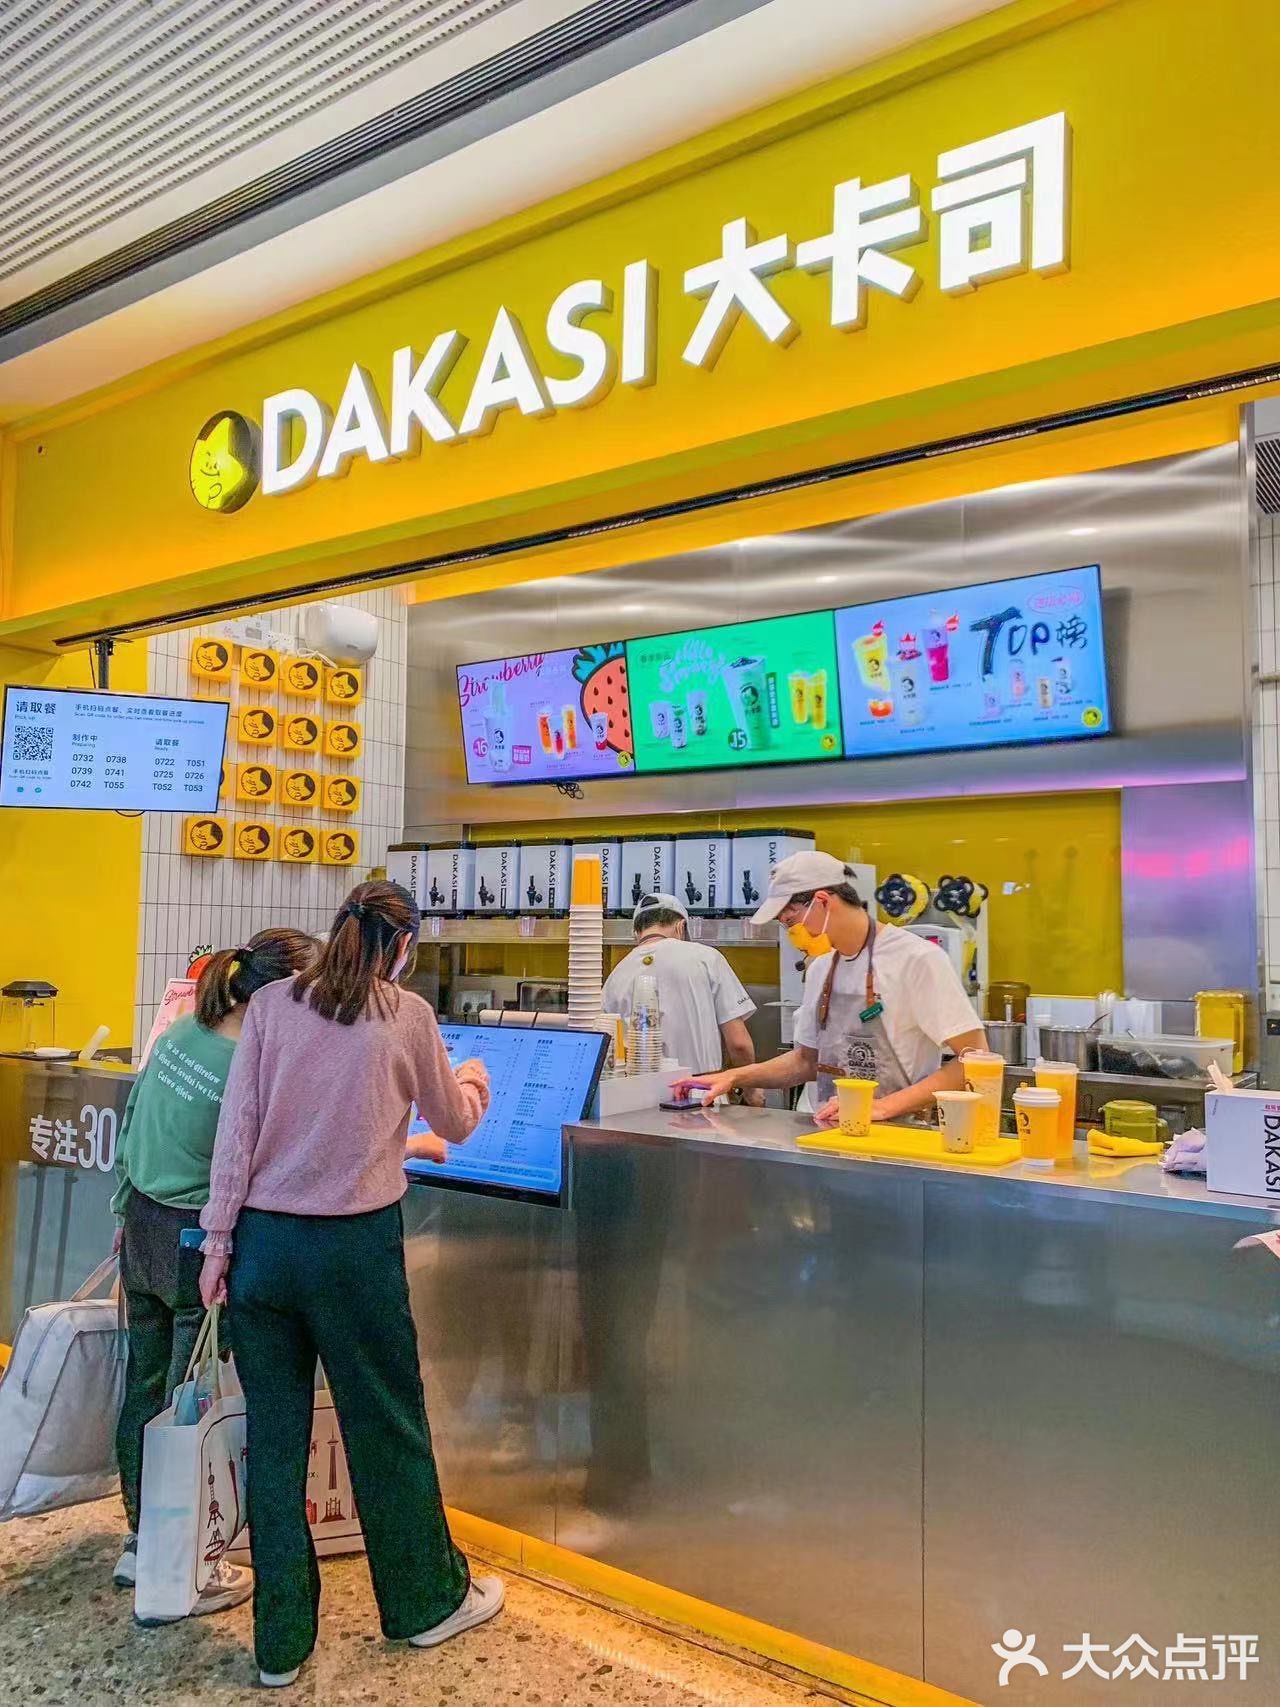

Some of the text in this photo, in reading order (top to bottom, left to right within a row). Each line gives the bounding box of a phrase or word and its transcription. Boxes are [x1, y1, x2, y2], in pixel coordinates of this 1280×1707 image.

[262, 111, 1070, 496] DAKASI 大卡司
[15, 701, 57, 715] 请取餐
[72, 733, 98, 742] 制作中
[155, 738, 180, 747] 请取餐
[731, 731, 746, 748] 15
[72, 753, 127, 764] 0732 0738
[154, 758, 205, 767] 0722 T051
[71, 767, 125, 776] 0739 0741
[153, 770, 204, 779] 0725 0726
[70, 780, 125, 789] 0742 T055
[152, 783, 203, 792] T052 T053
[500, 851, 508, 887] DAKASI
[548, 850, 556, 886] DAKASI
[601, 848, 609, 886] DAKASI
[653, 846, 661, 885] DAKASI
[708, 843, 716, 883] DAKASI
[848, 1060, 876, 1069] DAKASI
[28, 1104, 117, 1173] 专注30
[1263, 1114, 1280, 1193] DAKASI
